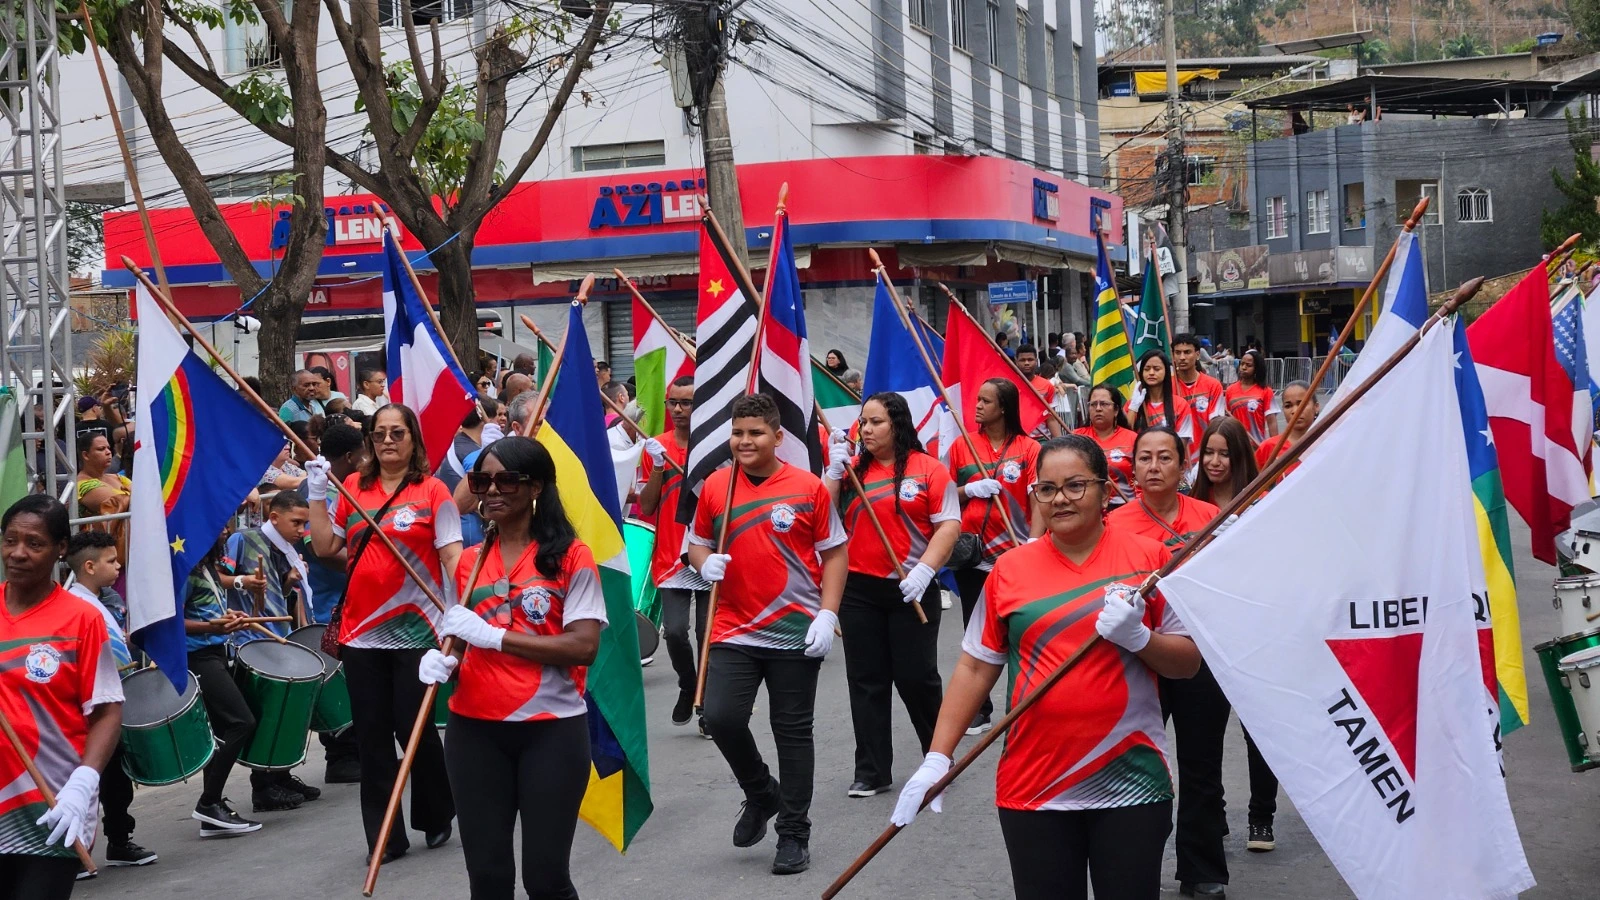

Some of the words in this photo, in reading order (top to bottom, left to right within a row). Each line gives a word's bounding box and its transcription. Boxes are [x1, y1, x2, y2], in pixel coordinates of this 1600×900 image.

[599, 178, 706, 196] DROGARI
[1350, 596, 1429, 630] LIBE
[1327, 687, 1415, 825] TAMEN
